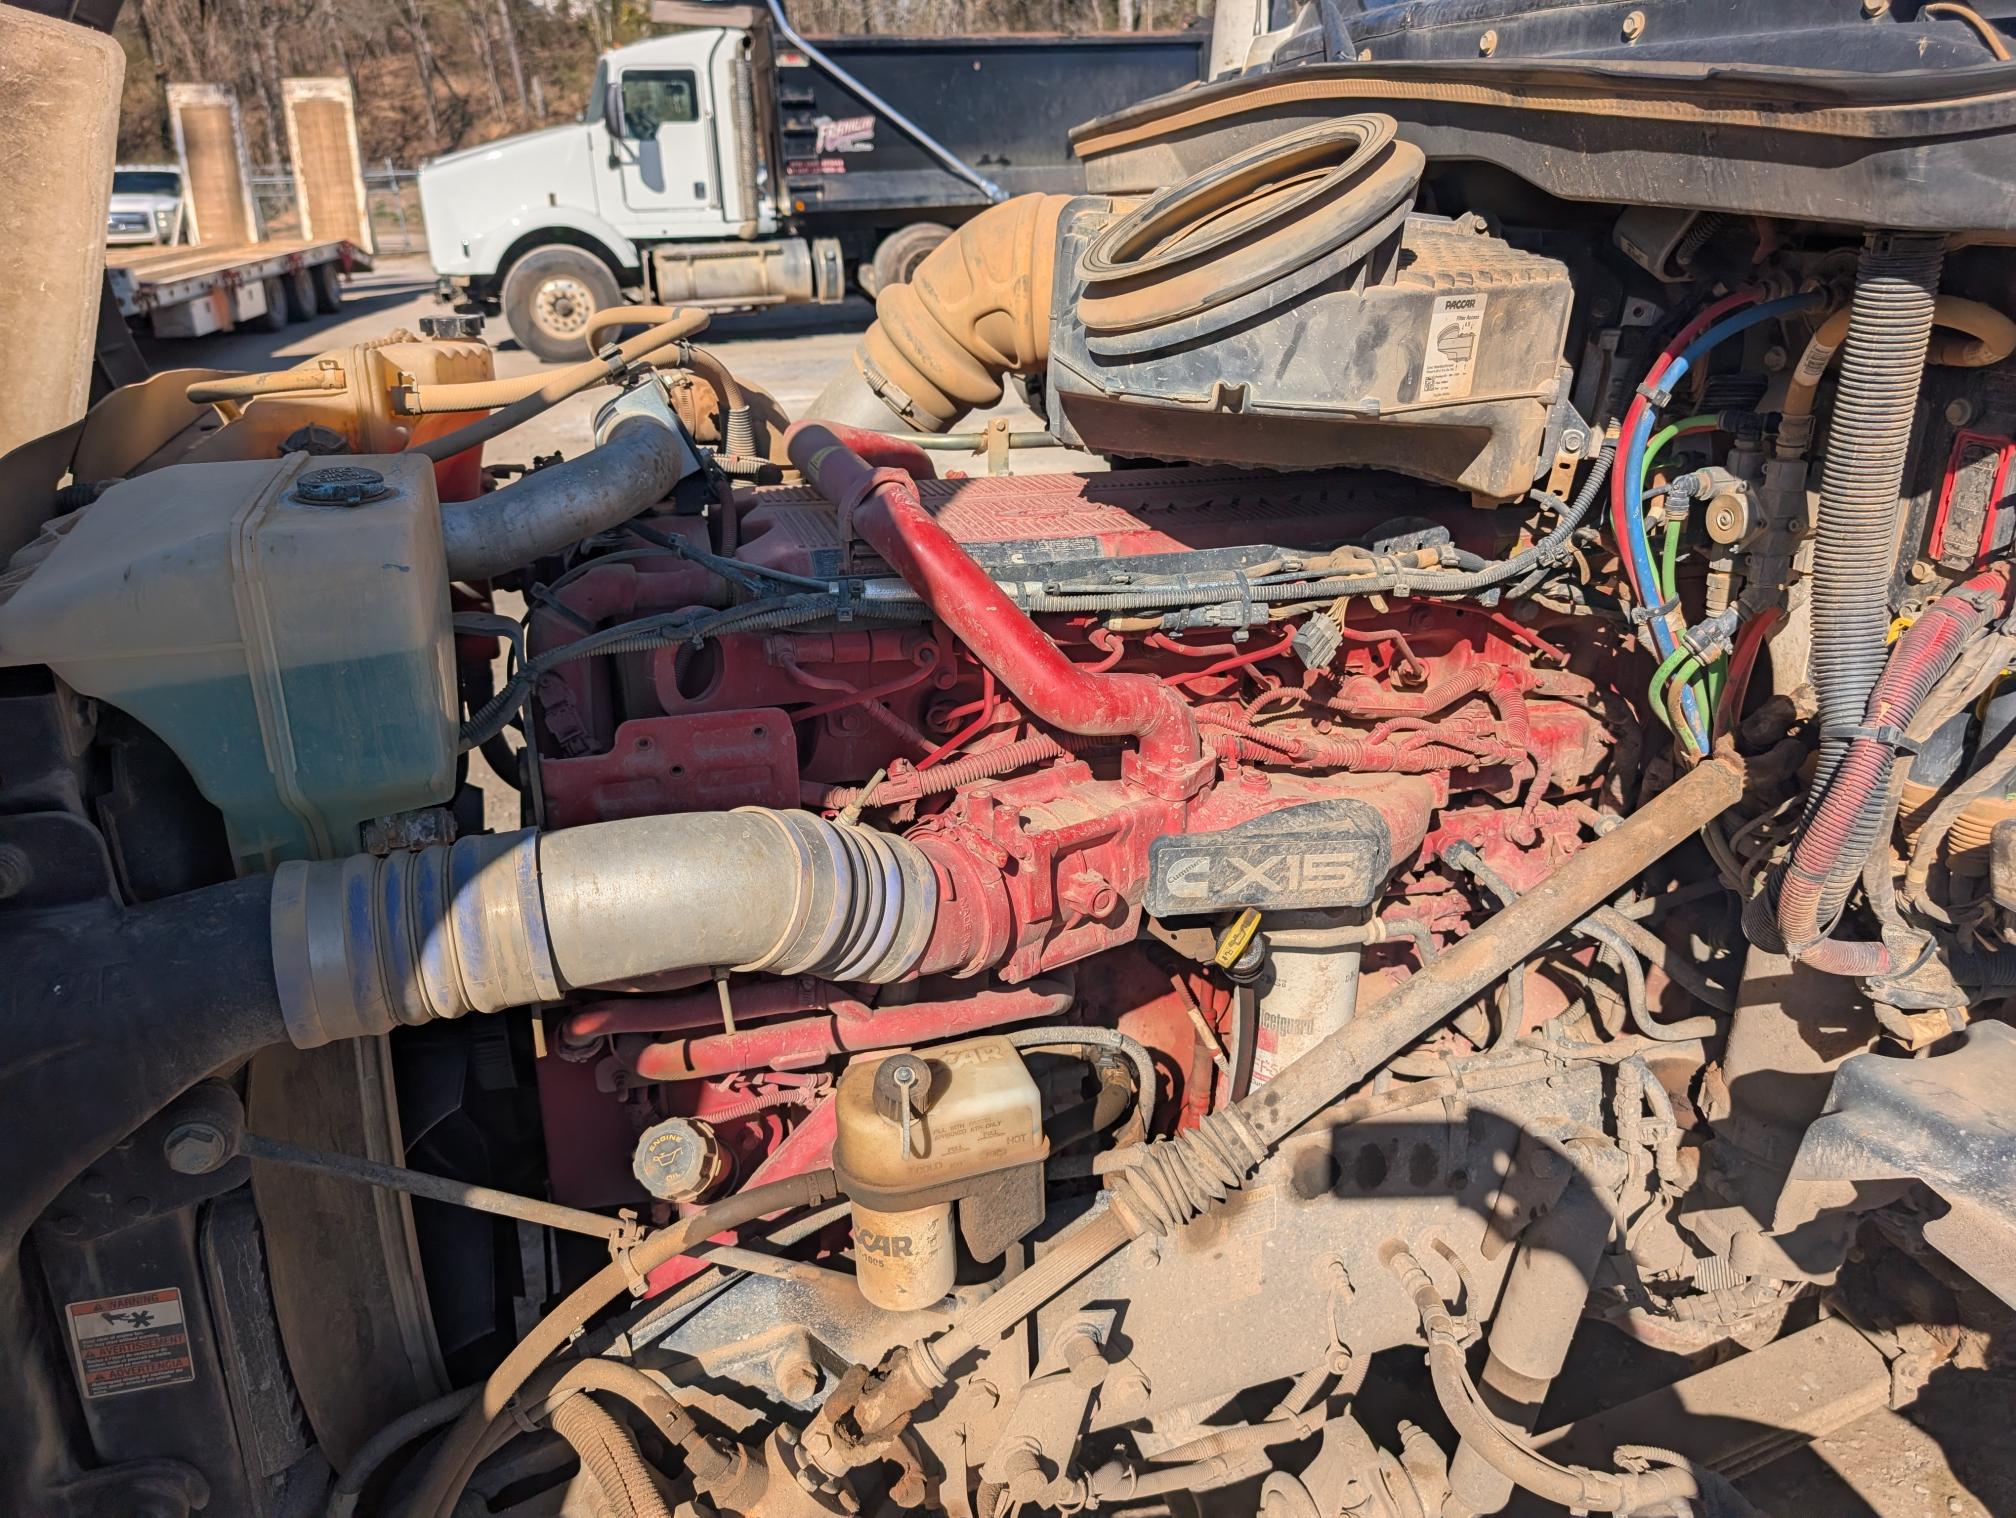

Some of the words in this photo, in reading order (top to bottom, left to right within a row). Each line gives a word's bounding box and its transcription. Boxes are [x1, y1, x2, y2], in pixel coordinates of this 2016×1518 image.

[1445, 299, 1476, 310] PACCAR
[1260, 1009, 1315, 1037] leetguard
[942, 1044, 1004, 1065] CAR
[649, 1134, 684, 1153] ENGINE
[1007, 1134, 1027, 1145] HOT
[666, 1172, 681, 1182] OIL
[101, 1334, 186, 1355] AVERTISSEMENT
